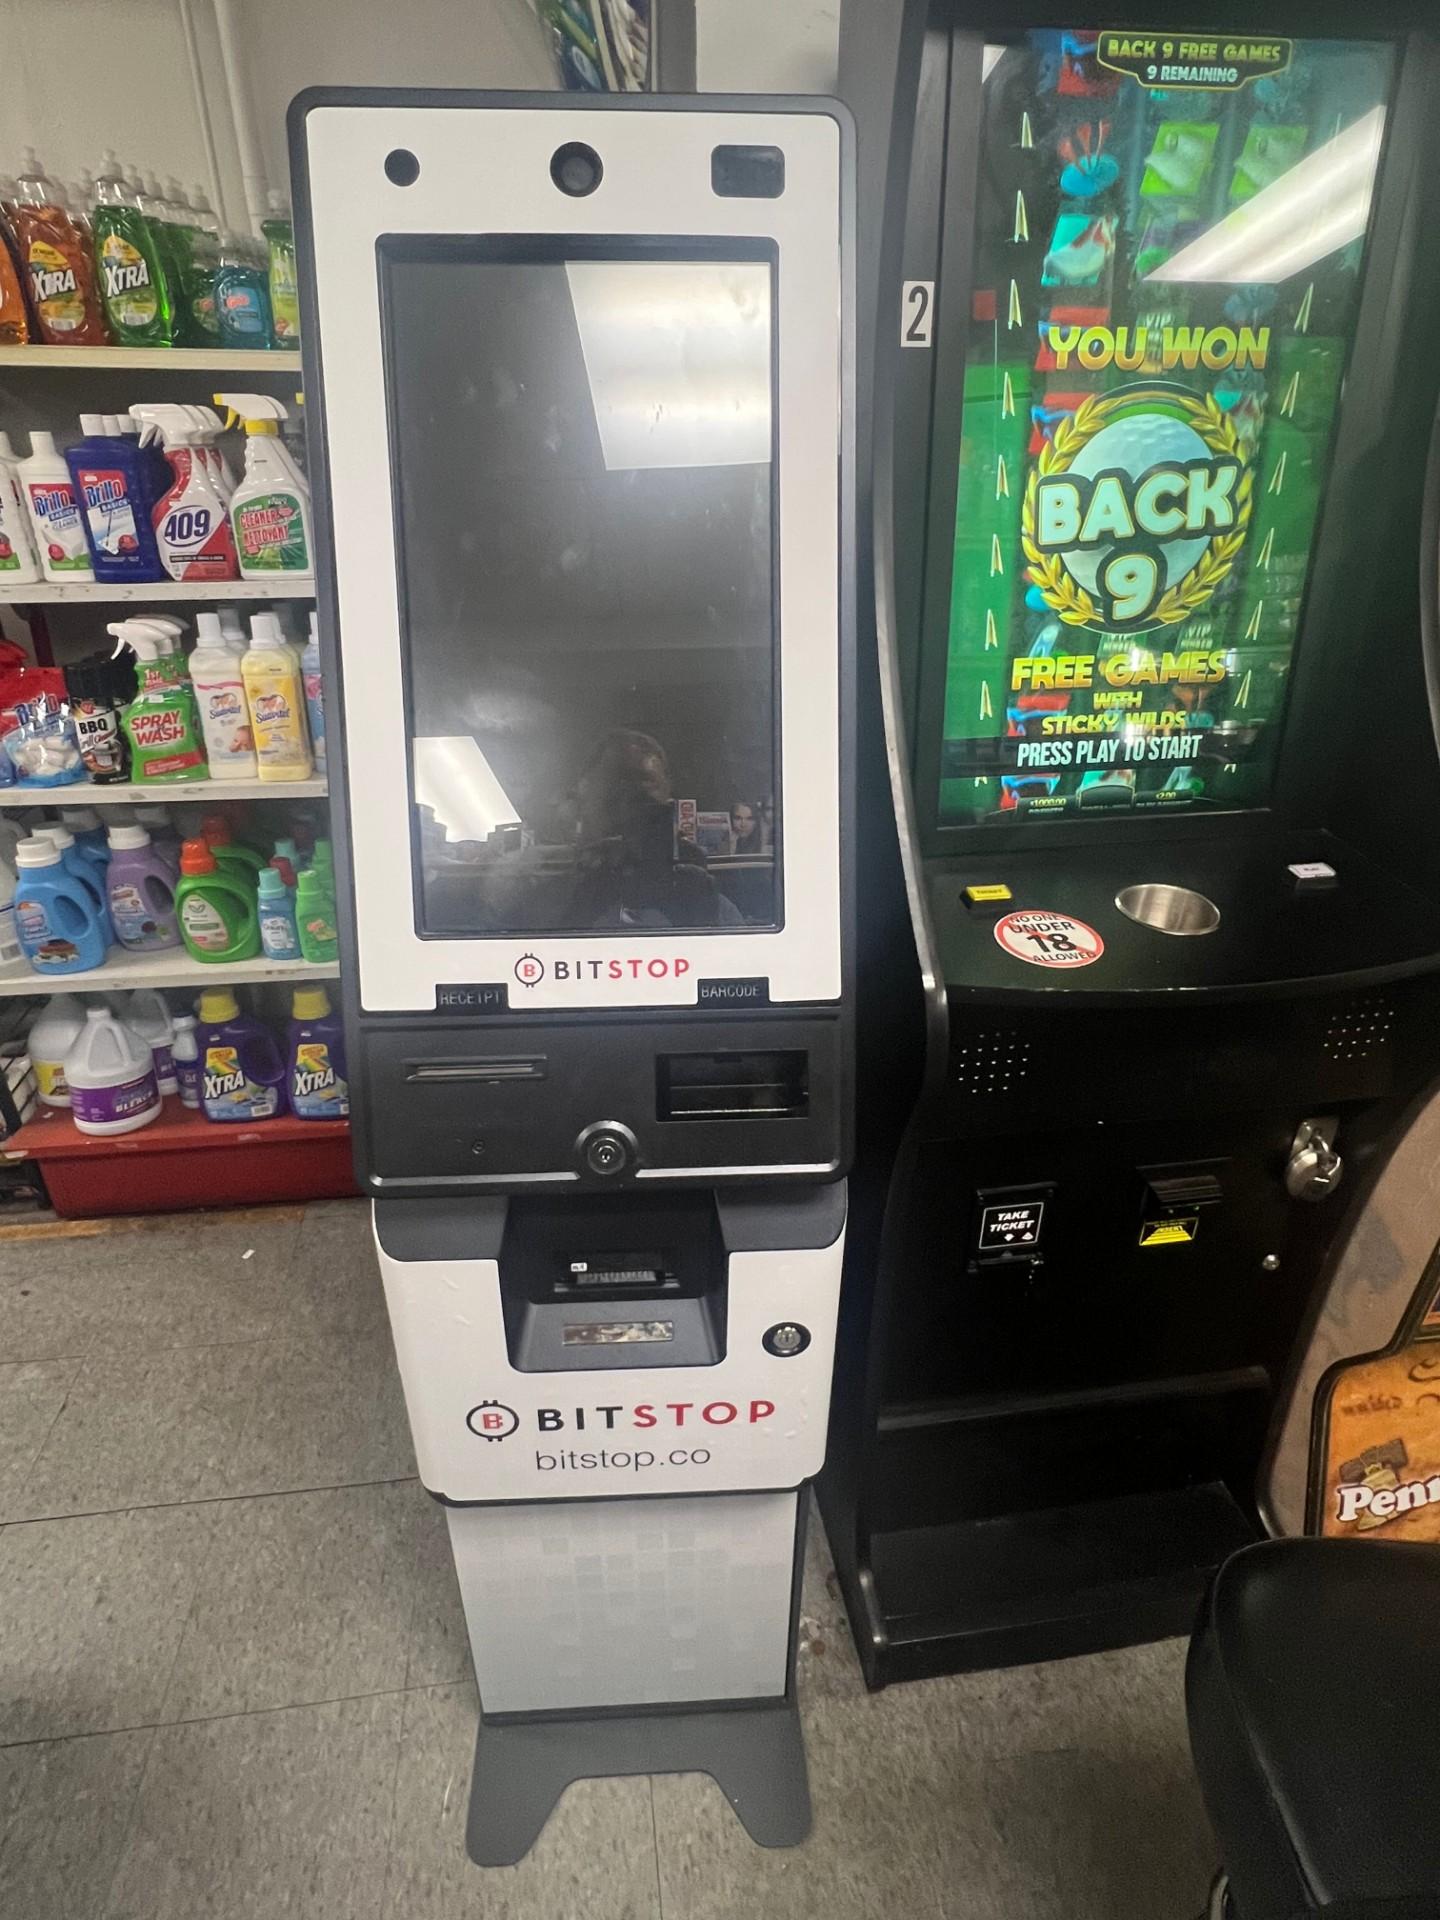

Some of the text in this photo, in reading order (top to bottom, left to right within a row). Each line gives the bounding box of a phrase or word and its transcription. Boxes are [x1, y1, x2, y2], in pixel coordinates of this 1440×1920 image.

[1108, 39, 1281, 62] BACK 9 FREE GAMES
[1147, 65, 1239, 83] 9 REMAINING
[32, 268, 77, 302] XTRA
[105, 261, 150, 298] XTRA
[906, 285, 929, 342] 2
[1048, 326, 1270, 370] YOU WON
[34, 489, 70, 516] Brillo
[85, 480, 124, 508] Brillo
[1038, 465, 1239, 546] BACK
[164, 509, 211, 542] 409
[1104, 554, 1158, 621] 9
[1011, 651, 1227, 690] FREE GAMES
[1093, 691, 1143, 709] WITH
[79, 718, 108, 735] BBQ
[131, 710, 180, 731] SPRAY
[1042, 711, 1188, 736] STICKY WILDS
[136, 725, 185, 746] WASH
[1017, 735, 1204, 768] PRESS PLAY TO START
[1009, 921, 1076, 934] UNDER
[1010, 914, 1061, 924] NO ONE
[1027, 933, 1077, 953] 18
[554, 958, 690, 980] BITSTOP
[1033, 951, 1097, 963] ALLOWED
[440, 990, 499, 1005] RECEIPT
[701, 985, 760, 998] BARCODE
[204, 1070, 245, 1099] XTRA
[294, 1067, 335, 1096] XTRA
[990, 1219, 1035, 1232] TICKET
[998, 1210, 1030, 1221] TAKE
[537, 1400, 775, 1432] BITSTOP
[536, 1448, 711, 1472] bitstop.co
